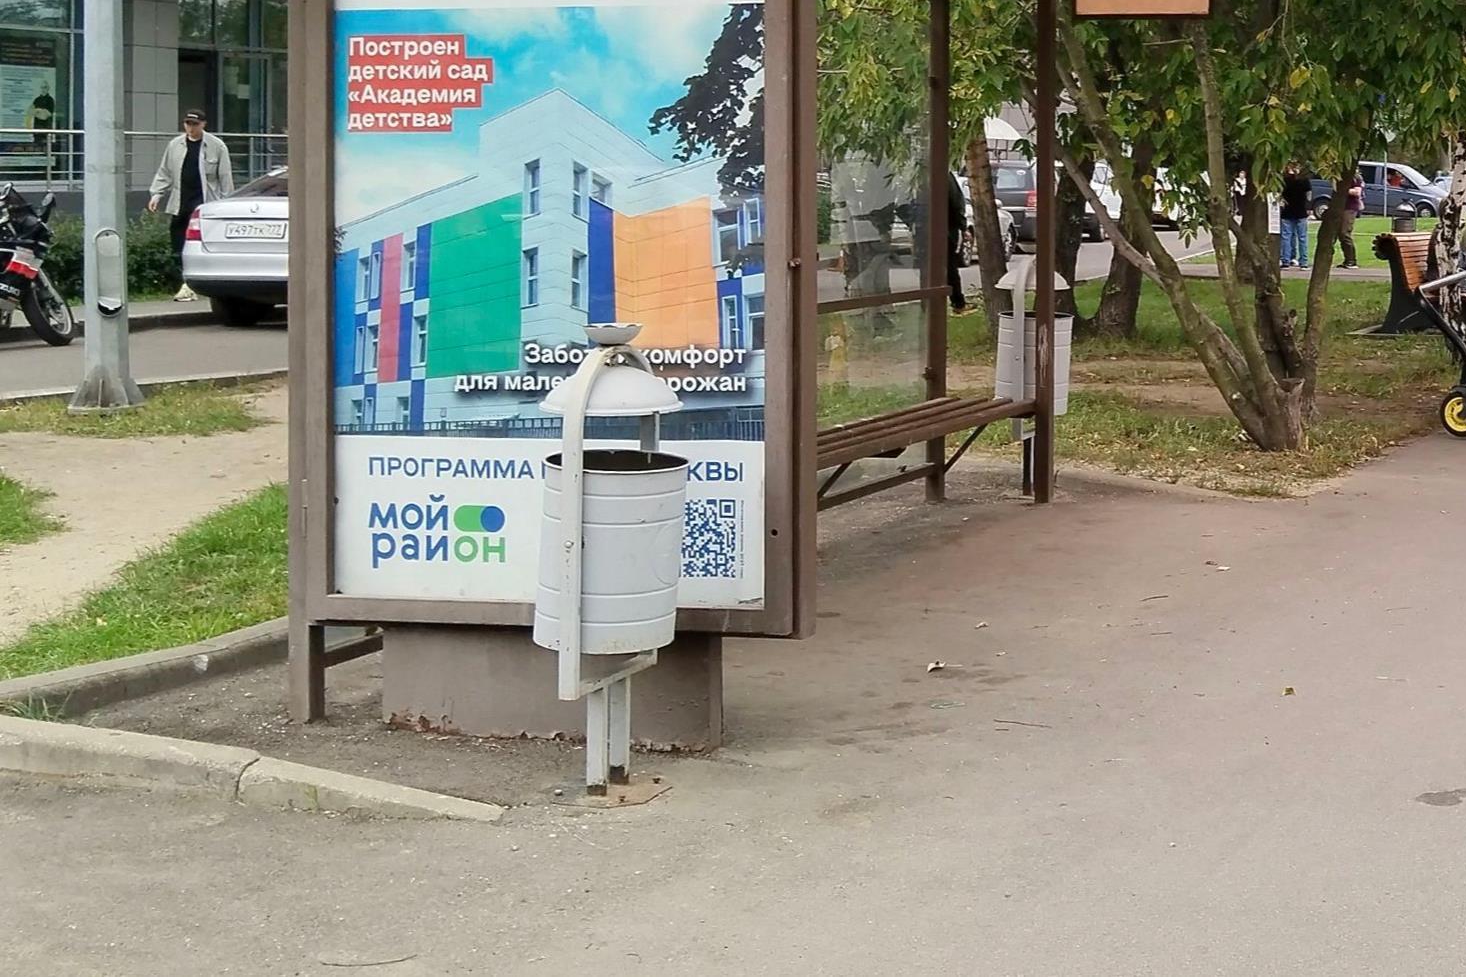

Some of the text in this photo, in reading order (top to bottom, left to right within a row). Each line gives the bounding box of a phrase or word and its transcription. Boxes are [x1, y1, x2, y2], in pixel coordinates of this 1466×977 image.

[348, 37, 460, 59] Построен
[348, 59, 489, 83] детский сад
[348, 85, 477, 105] «Академия
[348, 109, 453, 130] детства»
[524, 343, 590, 365] Забо
[454, 376, 498, 393] для
[368, 456, 535, 480] ПРОГРАММА
[687, 461, 744, 482] КВЫ
[368, 494, 449, 531] мой
